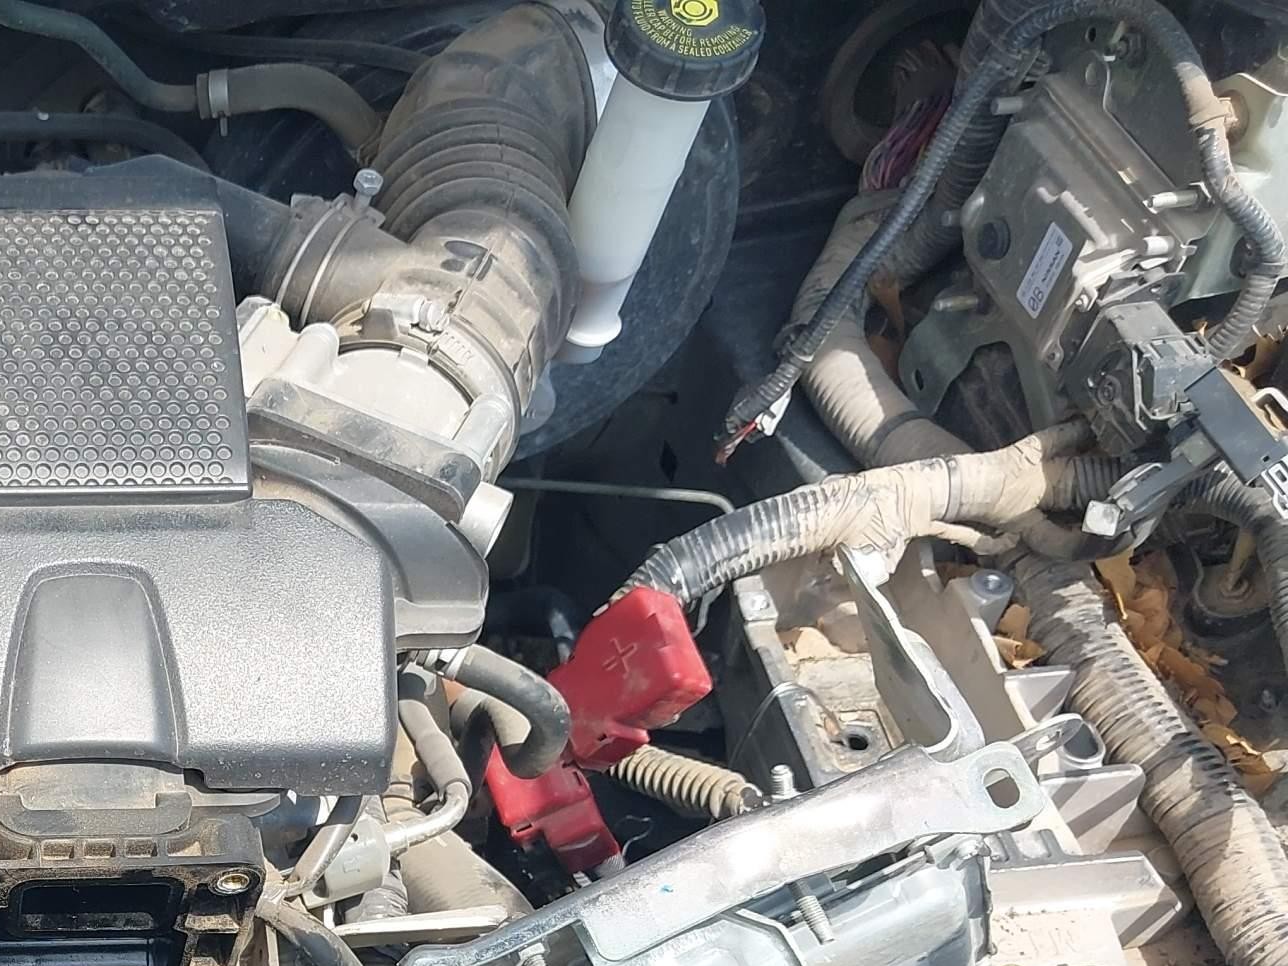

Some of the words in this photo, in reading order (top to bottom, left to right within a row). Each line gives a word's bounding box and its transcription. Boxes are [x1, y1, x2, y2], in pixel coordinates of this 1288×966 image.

[649, 18, 666, 31] CAP
[663, 30, 697, 46] BEFORE
[700, 25, 741, 46] REMOVING
[657, 9, 694, 37] WARNING
[678, 44, 712, 57] SEALED
